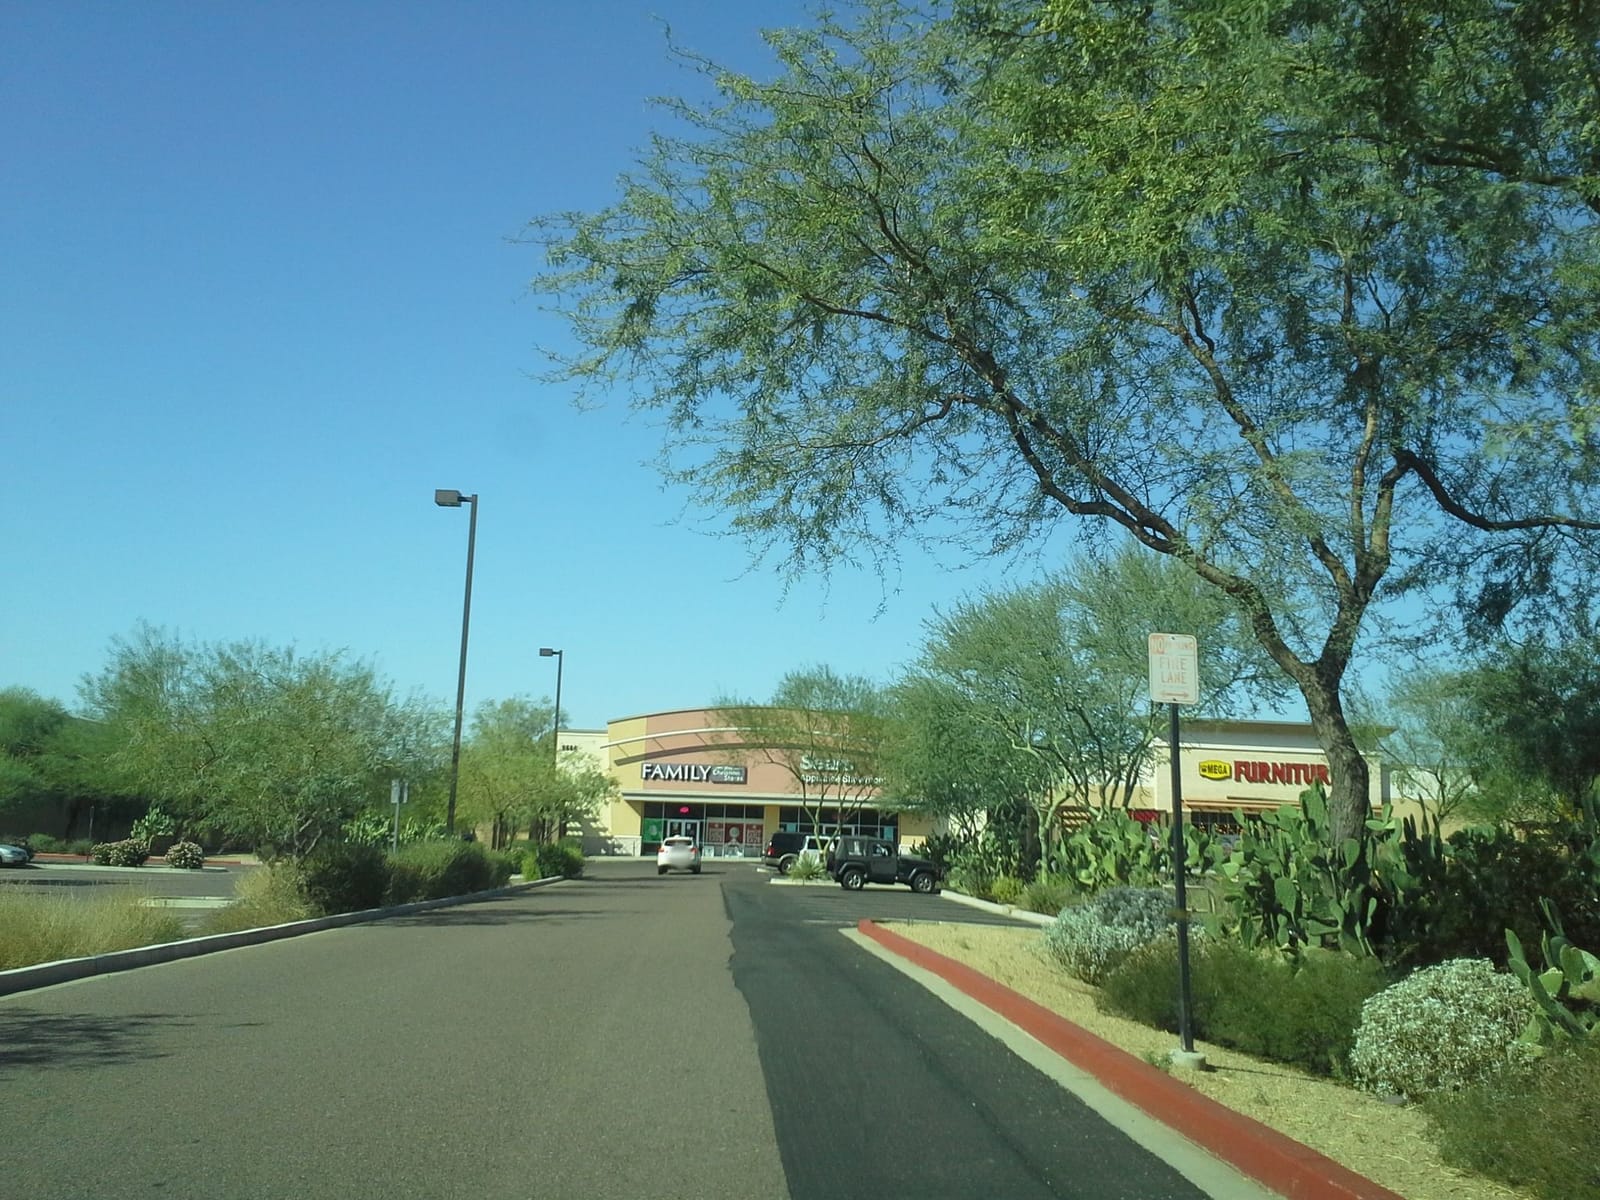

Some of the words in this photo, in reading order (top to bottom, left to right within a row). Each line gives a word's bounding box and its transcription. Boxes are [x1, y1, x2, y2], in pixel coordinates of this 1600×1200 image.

[1161, 671, 1187, 684] LANE
[642, 763, 712, 781] FAMILY
[1207, 764, 1228, 775] MEGA
[1233, 760, 1332, 786] FURNITUR
